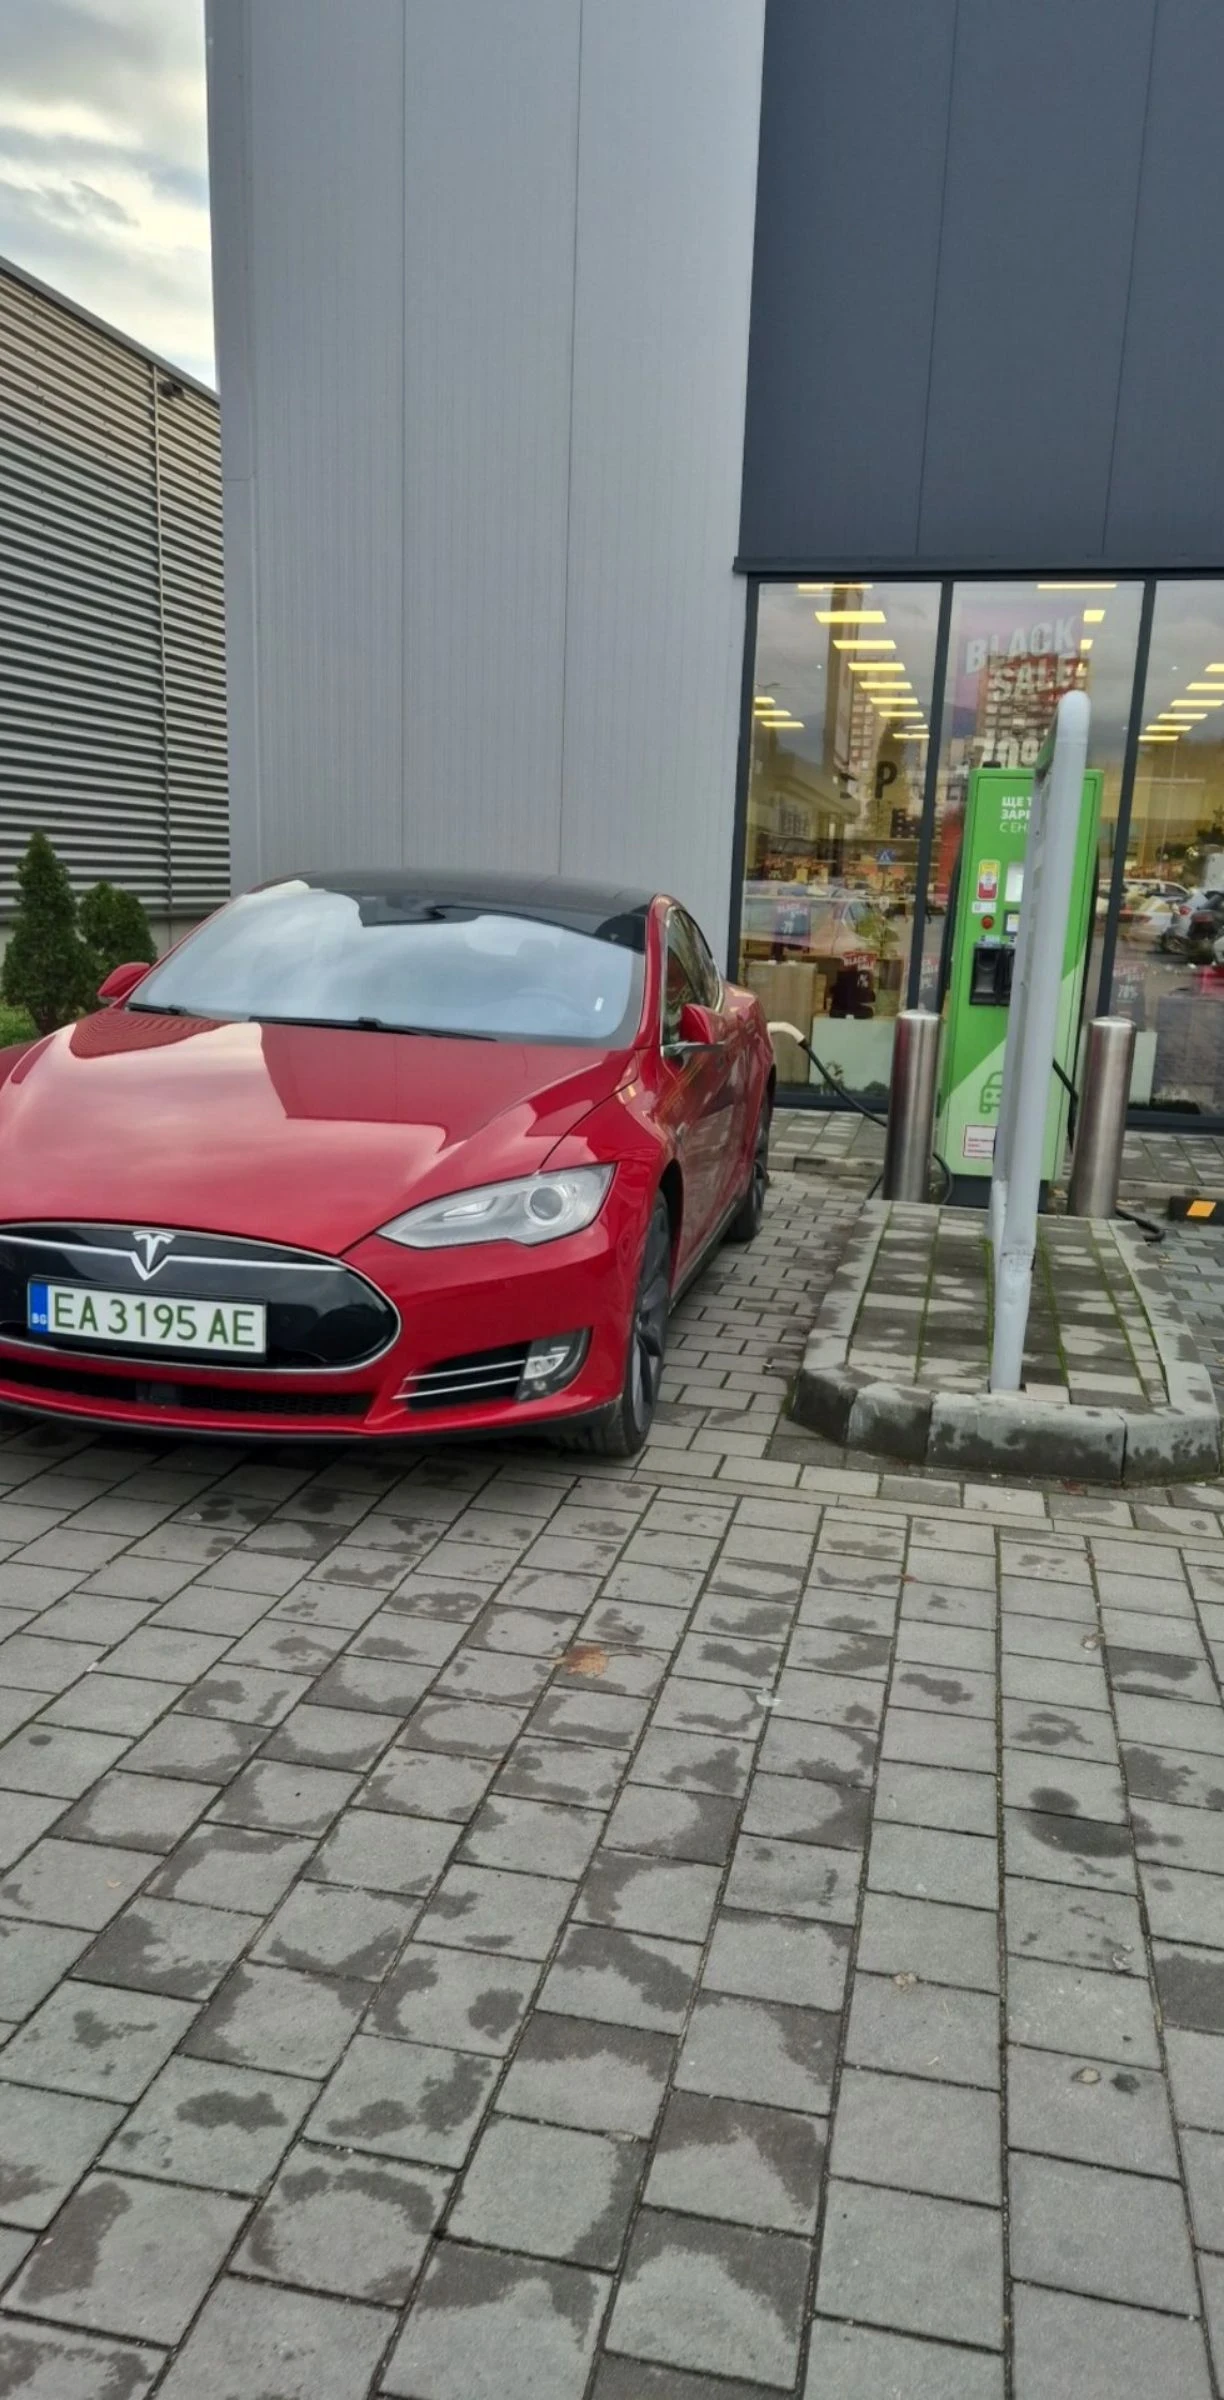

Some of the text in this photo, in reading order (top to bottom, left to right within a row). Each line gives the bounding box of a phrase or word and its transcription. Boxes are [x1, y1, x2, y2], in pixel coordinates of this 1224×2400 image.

[965, 616, 1077, 674] BLACK
[1002, 796, 1024, 808] ЩЕ
[1010, 822, 1028, 833] ЕН
[32, 1292, 255, 1346] BG EA 3195 AE
